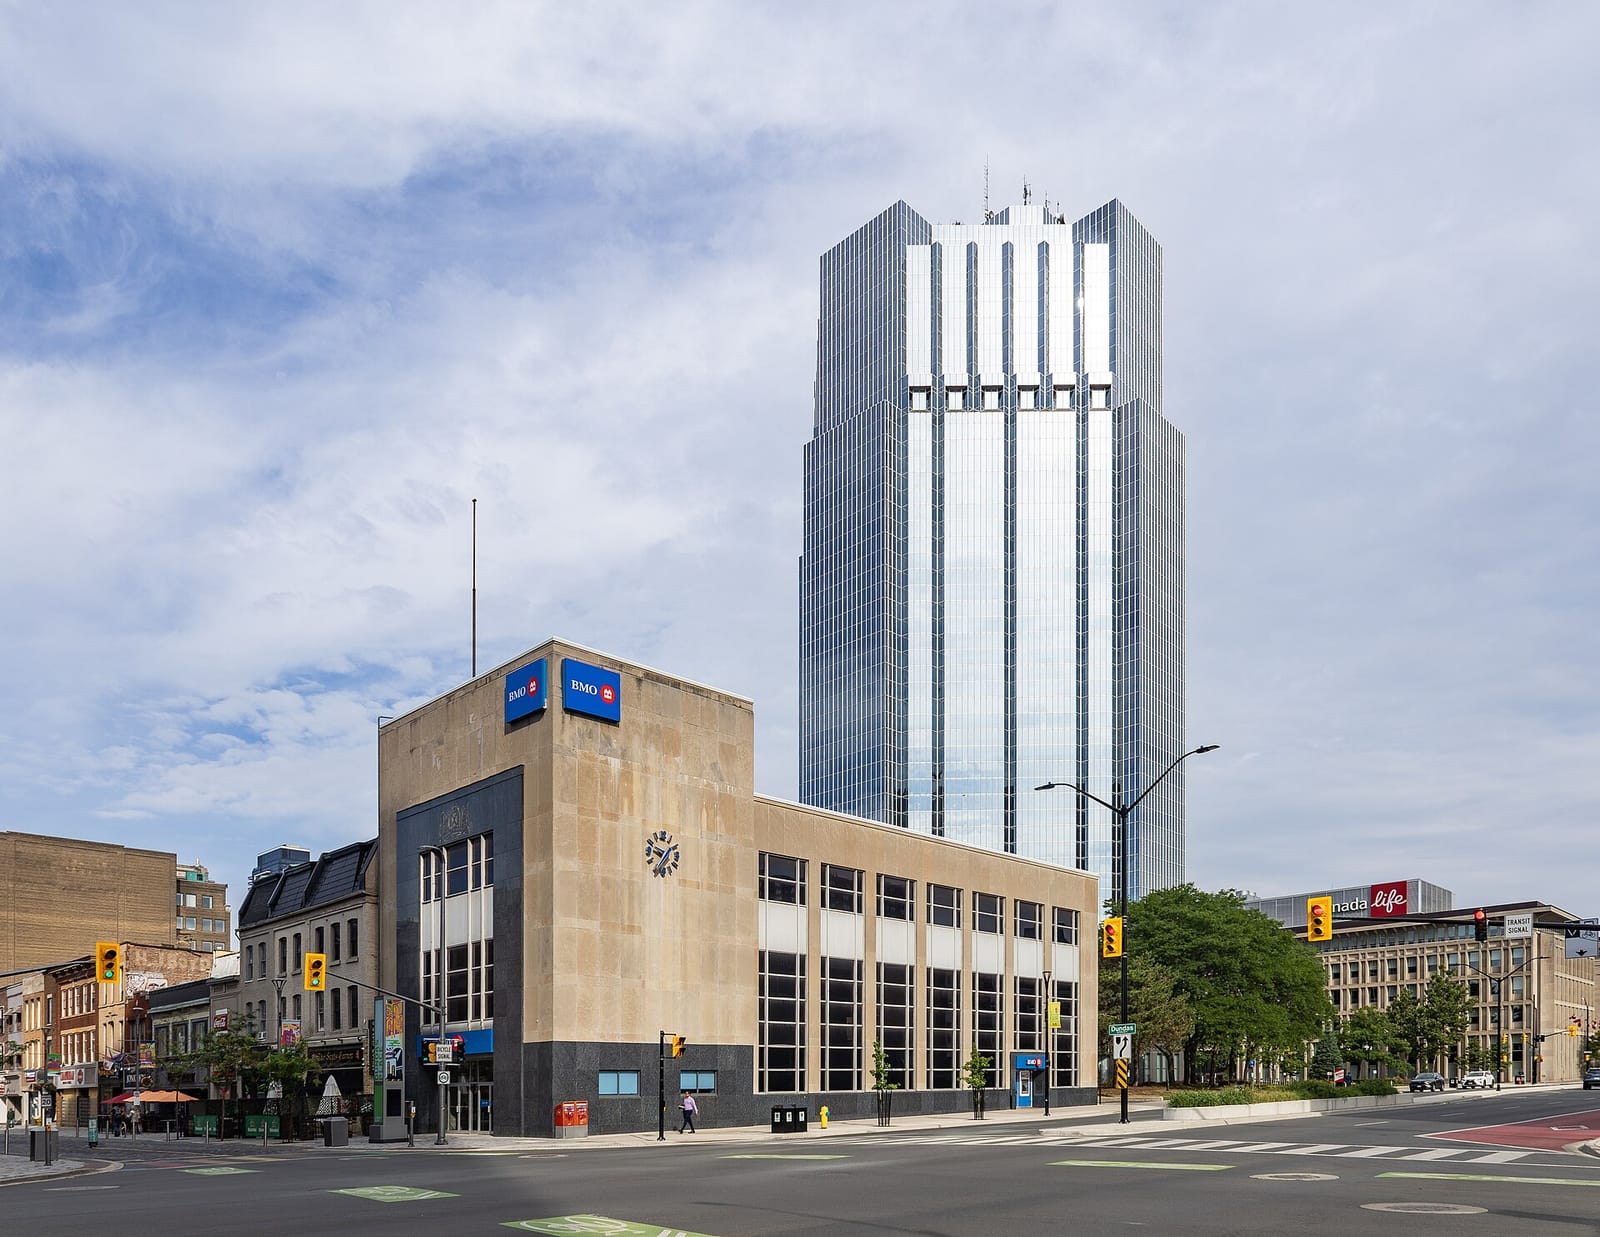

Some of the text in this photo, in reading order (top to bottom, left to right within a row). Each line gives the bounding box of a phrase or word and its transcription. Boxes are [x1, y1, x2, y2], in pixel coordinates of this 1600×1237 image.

[508, 686, 526, 702] BMO
[571, 679, 598, 696] BMO
[1331, 889, 1407, 913] nada life
[1507, 917, 1531, 926] TRANSIT
[42, 1098, 51, 1106] 20
